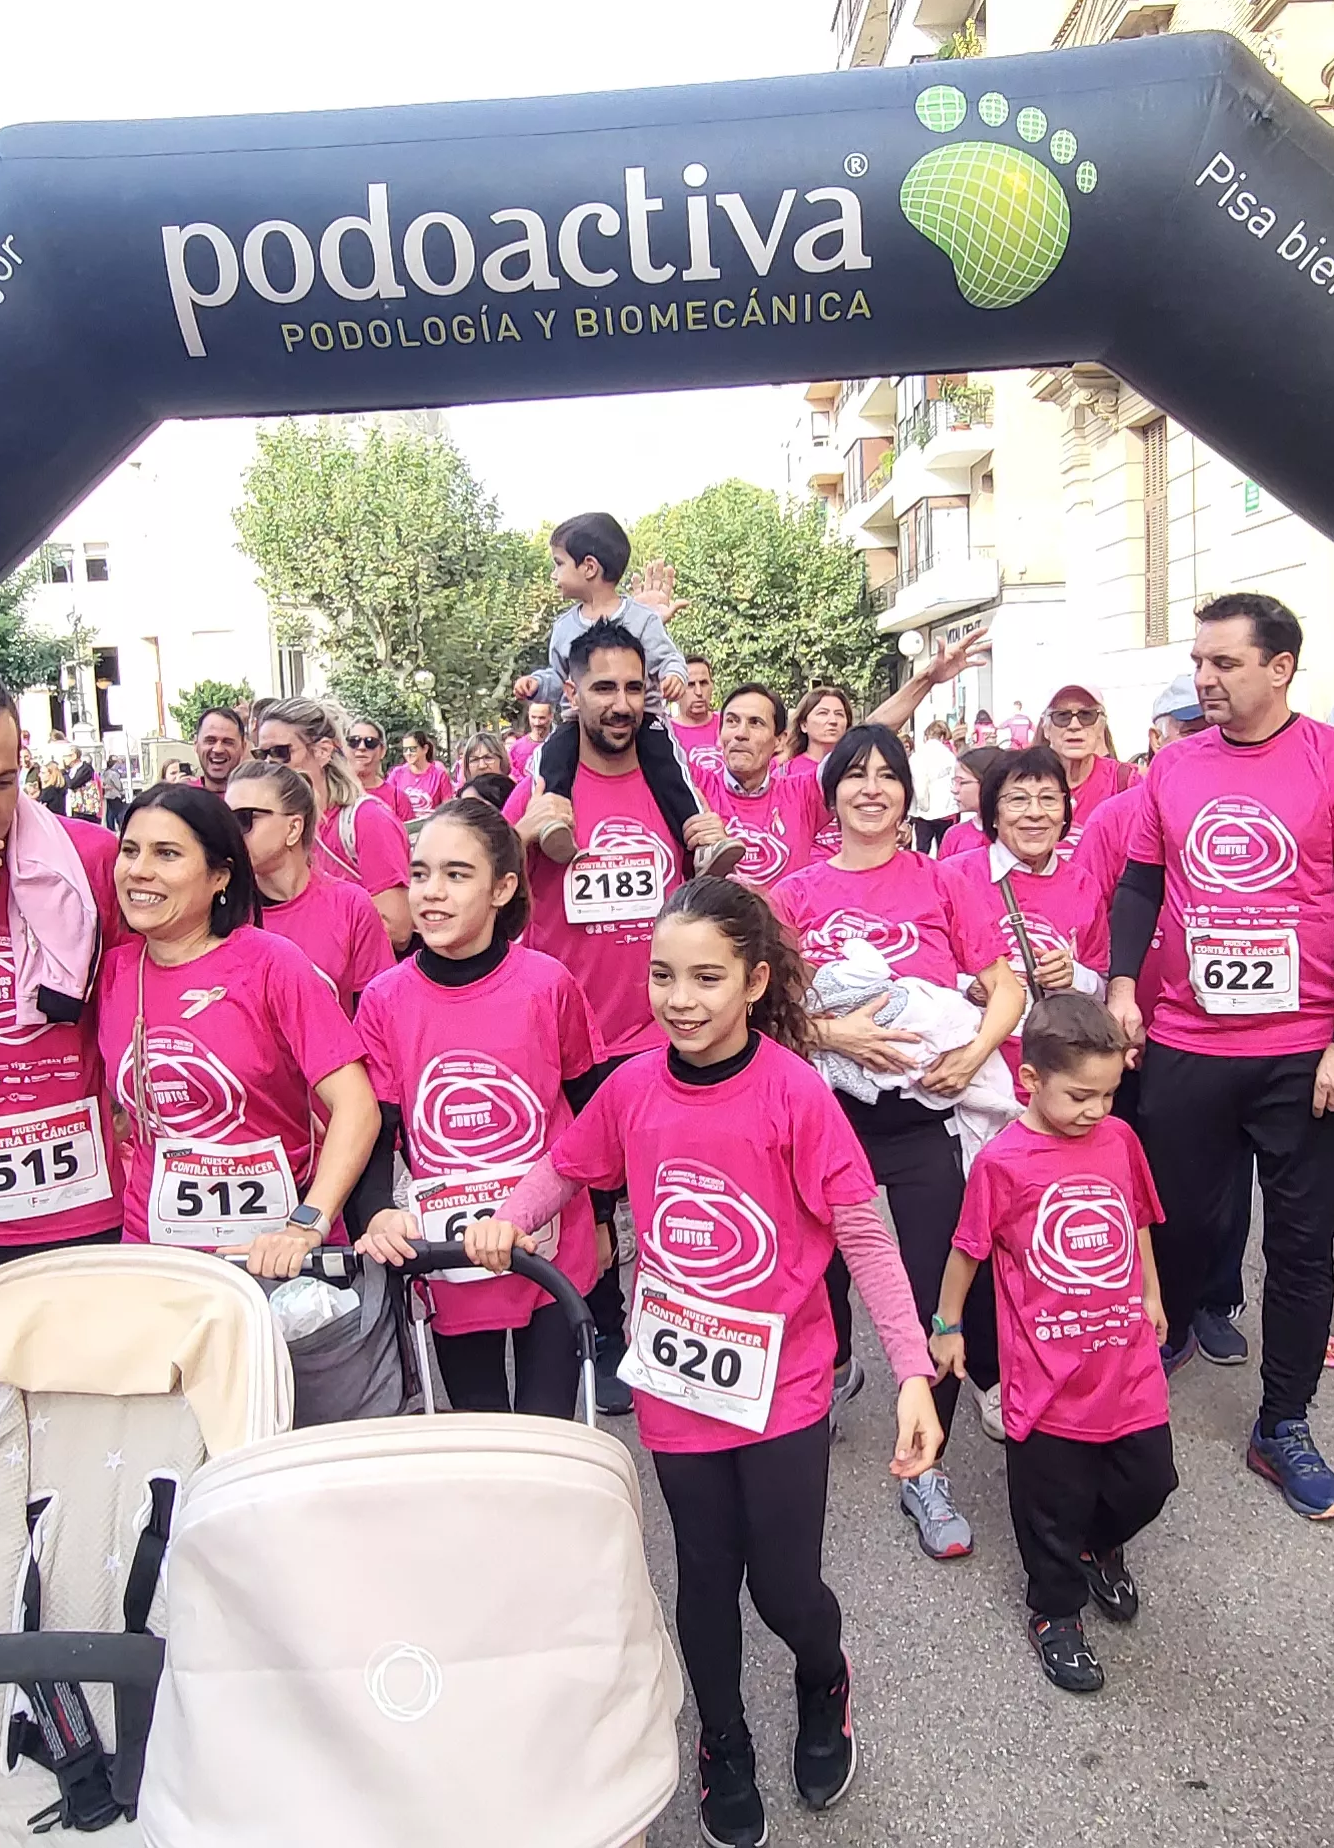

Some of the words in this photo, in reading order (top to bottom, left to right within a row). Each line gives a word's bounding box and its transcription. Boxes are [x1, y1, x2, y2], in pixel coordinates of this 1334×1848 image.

[1195, 151, 1277, 240] Pisa
[161, 163, 872, 358] podoactiva
[281, 304, 522, 354] PODOLOGÍA
[536, 310, 556, 340] Y
[575, 287, 873, 338] BIOMECÁNICA
[574, 870, 654, 901] 2183
[1194, 946, 1232, 955] CONTRA
[1233, 947, 1244, 956] EL
[1245, 945, 1286, 956] CÁNCER
[1204, 959, 1274, 991] 622
[11, 1121, 48, 1136] HUESCA
[449, 1111, 491, 1128] JUNTOS
[25, 1134, 40, 1144] EL
[42, 1121, 87, 1141] CÁNCER
[171, 1161, 210, 1176] CONTRA
[211, 1166, 226, 1176] EL
[228, 1161, 275, 1175] CÁNCER
[200, 1156, 235, 1166] HUESCA
[176, 1179, 268, 1217] 512
[464, 1181, 501, 1193] HUESCA
[426, 1192, 477, 1211] CONTRA
[478, 1190, 493, 1202] EL
[668, 1228, 712, 1246] JUNTOS
[646, 1301, 691, 1330] CONTRA
[693, 1322, 707, 1335] EL
[708, 1326, 763, 1347] CÁNCER
[682, 1308, 719, 1327] HUESCA
[652, 1328, 742, 1388] 620
